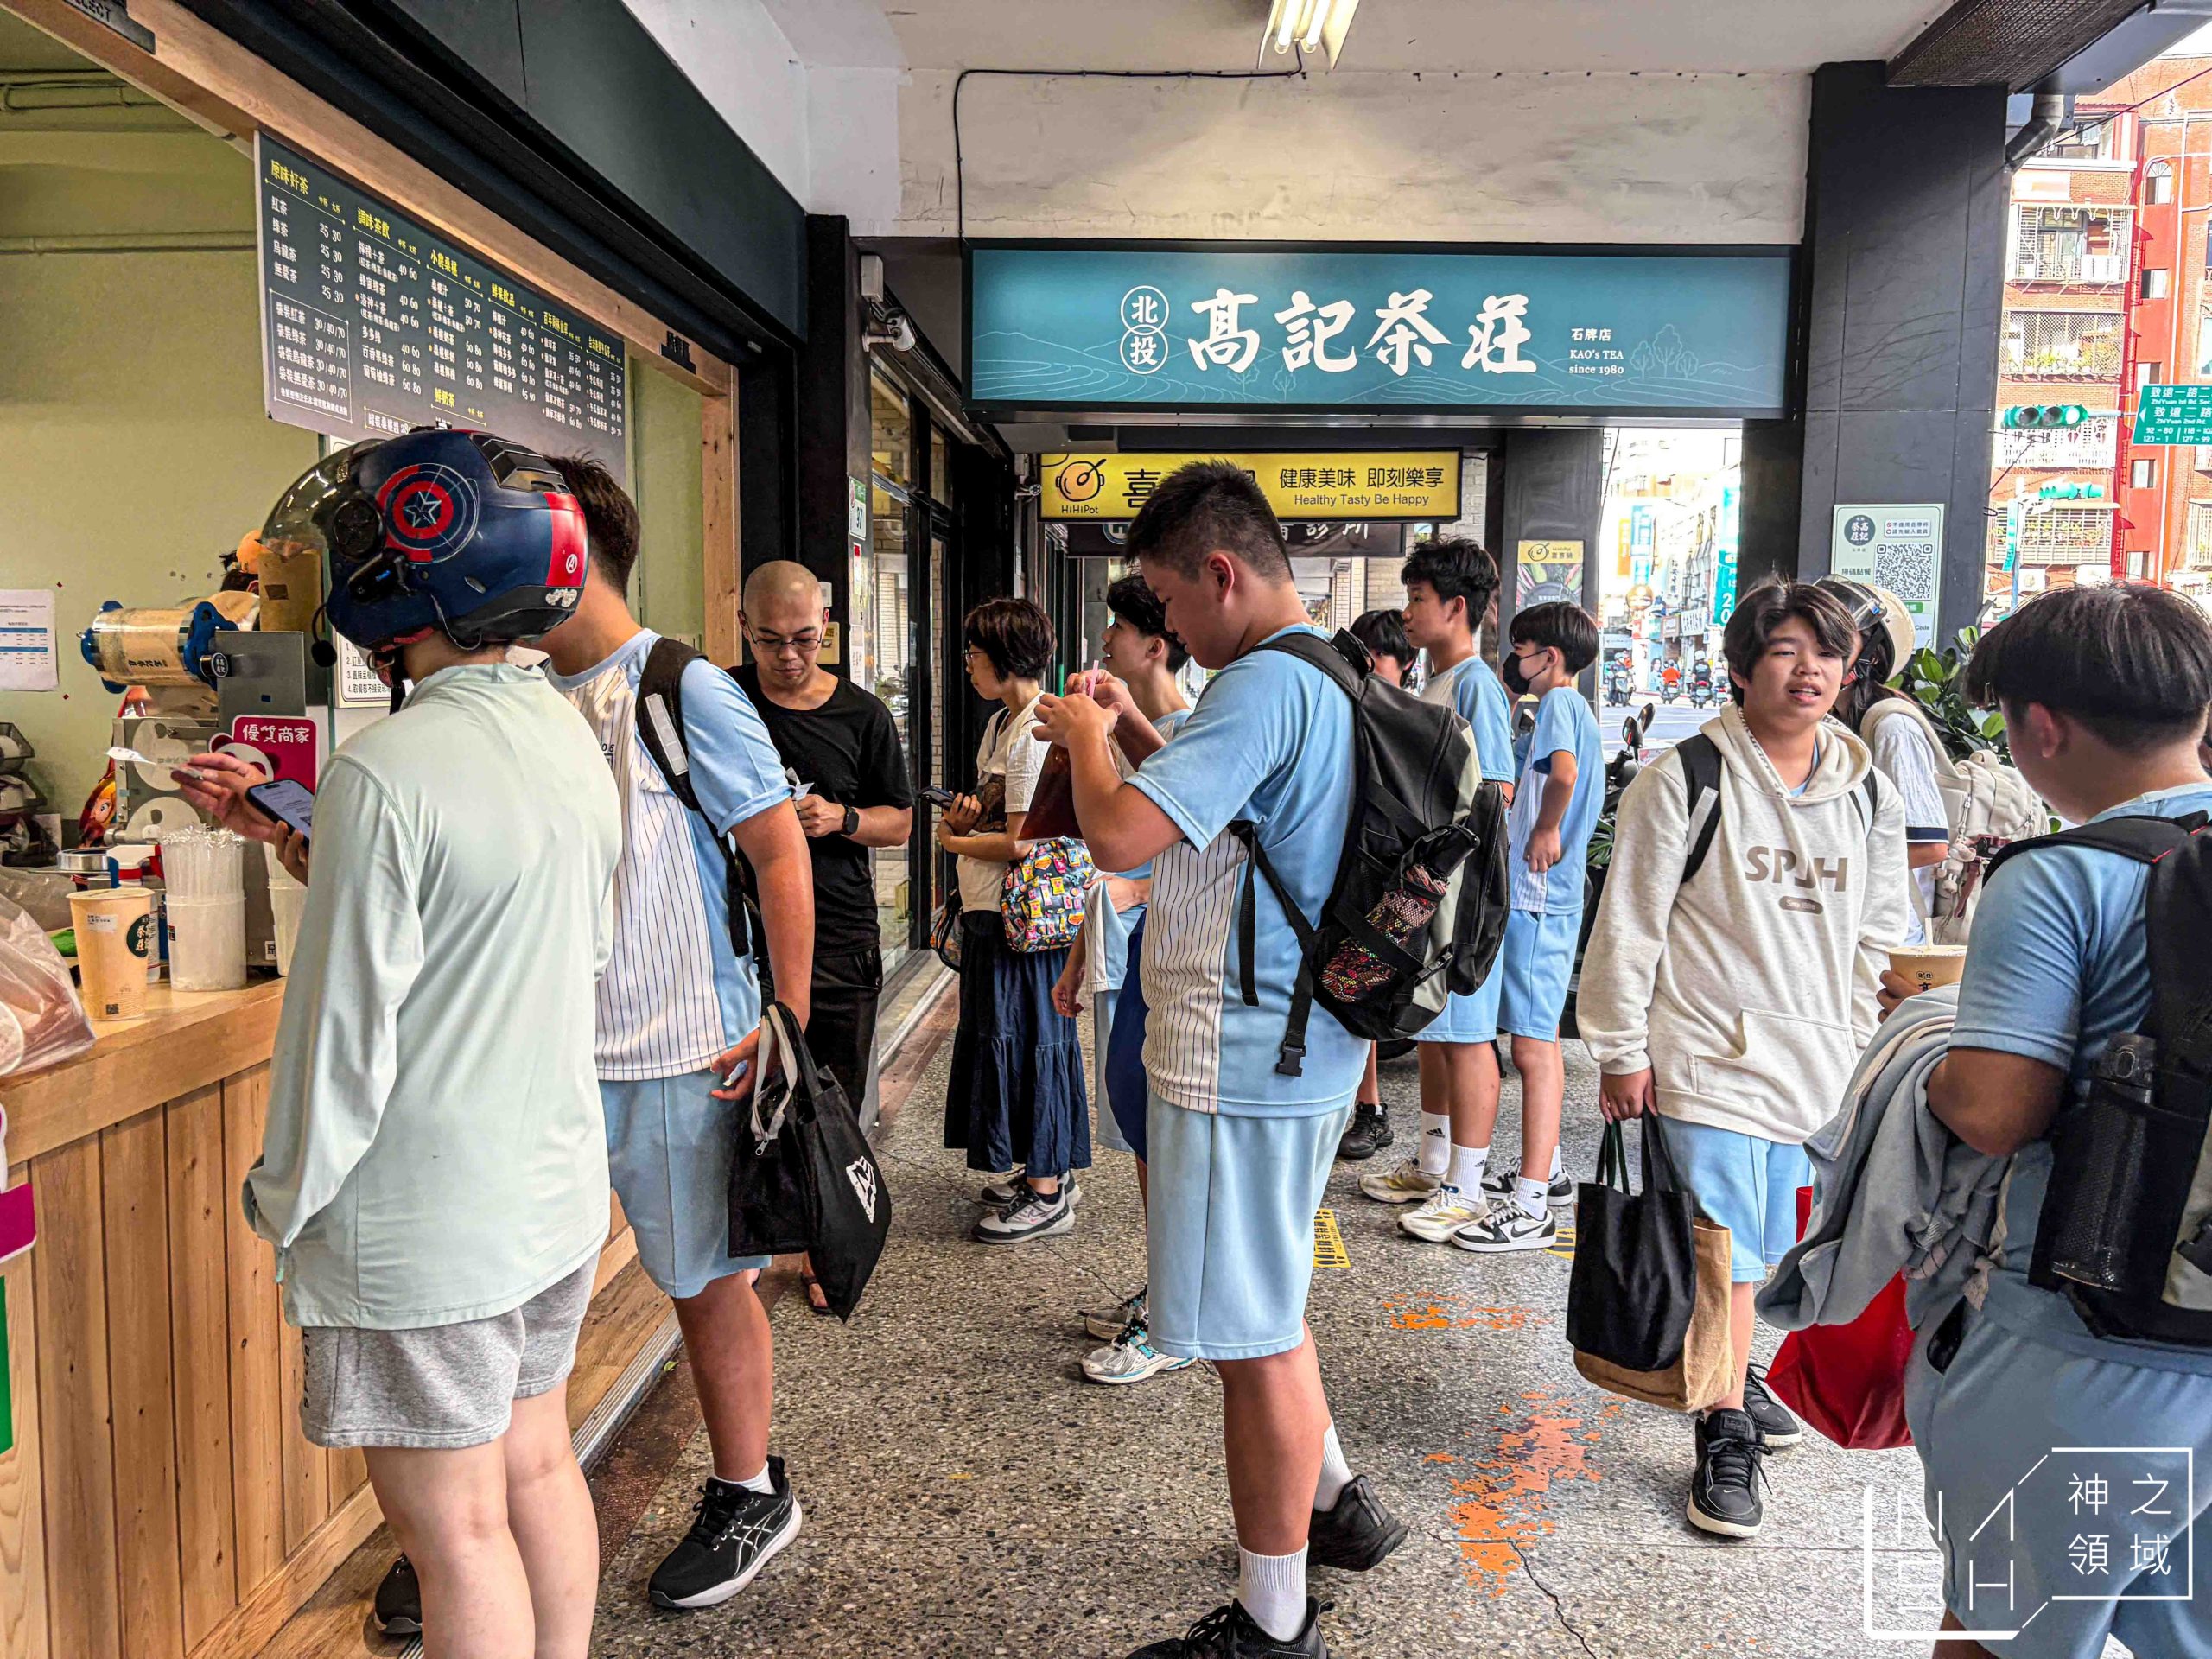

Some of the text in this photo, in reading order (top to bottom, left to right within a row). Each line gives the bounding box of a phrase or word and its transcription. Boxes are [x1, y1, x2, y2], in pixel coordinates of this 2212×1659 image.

[271, 160, 308, 194] 原味好茶
[271, 196, 341, 242] 紅茶 25 30
[358, 207, 390, 239] 調味茶飲
[273, 218, 342, 262] 綠茶 25 30
[274, 240, 343, 283] 烏龍茶 25 30
[398, 264, 407, 276] 40
[409, 268, 417, 280] 60
[322, 285, 331, 299] 25
[334, 290, 343, 302] 30
[400, 295, 408, 306] 40
[410, 297, 418, 310] 60
[465, 298, 472, 308] 50
[474, 302, 480, 312] 70
[400, 314, 408, 325] 40
[411, 316, 419, 328] 60
[466, 315, 472, 326] 50
[474, 320, 480, 329] 70
[528, 329, 534, 340] 60
[1571, 327, 1611, 342] 石牌店
[401, 344, 410, 355] 40
[412, 346, 420, 358] 60
[466, 341, 473, 353] 60
[475, 345, 481, 356] 80
[529, 345, 534, 355] 60
[1569, 350, 1624, 359] KAO's TEA
[363, 345, 420, 377] 百香果綠茶 60 80
[467, 358, 474, 370] 60
[475, 361, 482, 373] 80
[521, 356, 527, 367] 60
[521, 372, 527, 383] 60
[1568, 365, 1624, 375] since 1980
[363, 365, 421, 394] 葡萄柚綠茶 60 80
[467, 375, 474, 386] 60
[476, 378, 482, 390] 80
[435, 388, 454, 408] 鮮奶茶
[2150, 387, 2212, 398] 致遠一路二
[1279, 467, 1356, 488] 健康美味
[1366, 467, 1444, 488] 即刻樂享
[1294, 494, 1429, 506] Healthy Tasty Be Happy
[1061, 505, 1098, 514] HiHiPot
[243, 724, 310, 743] 優質商家
